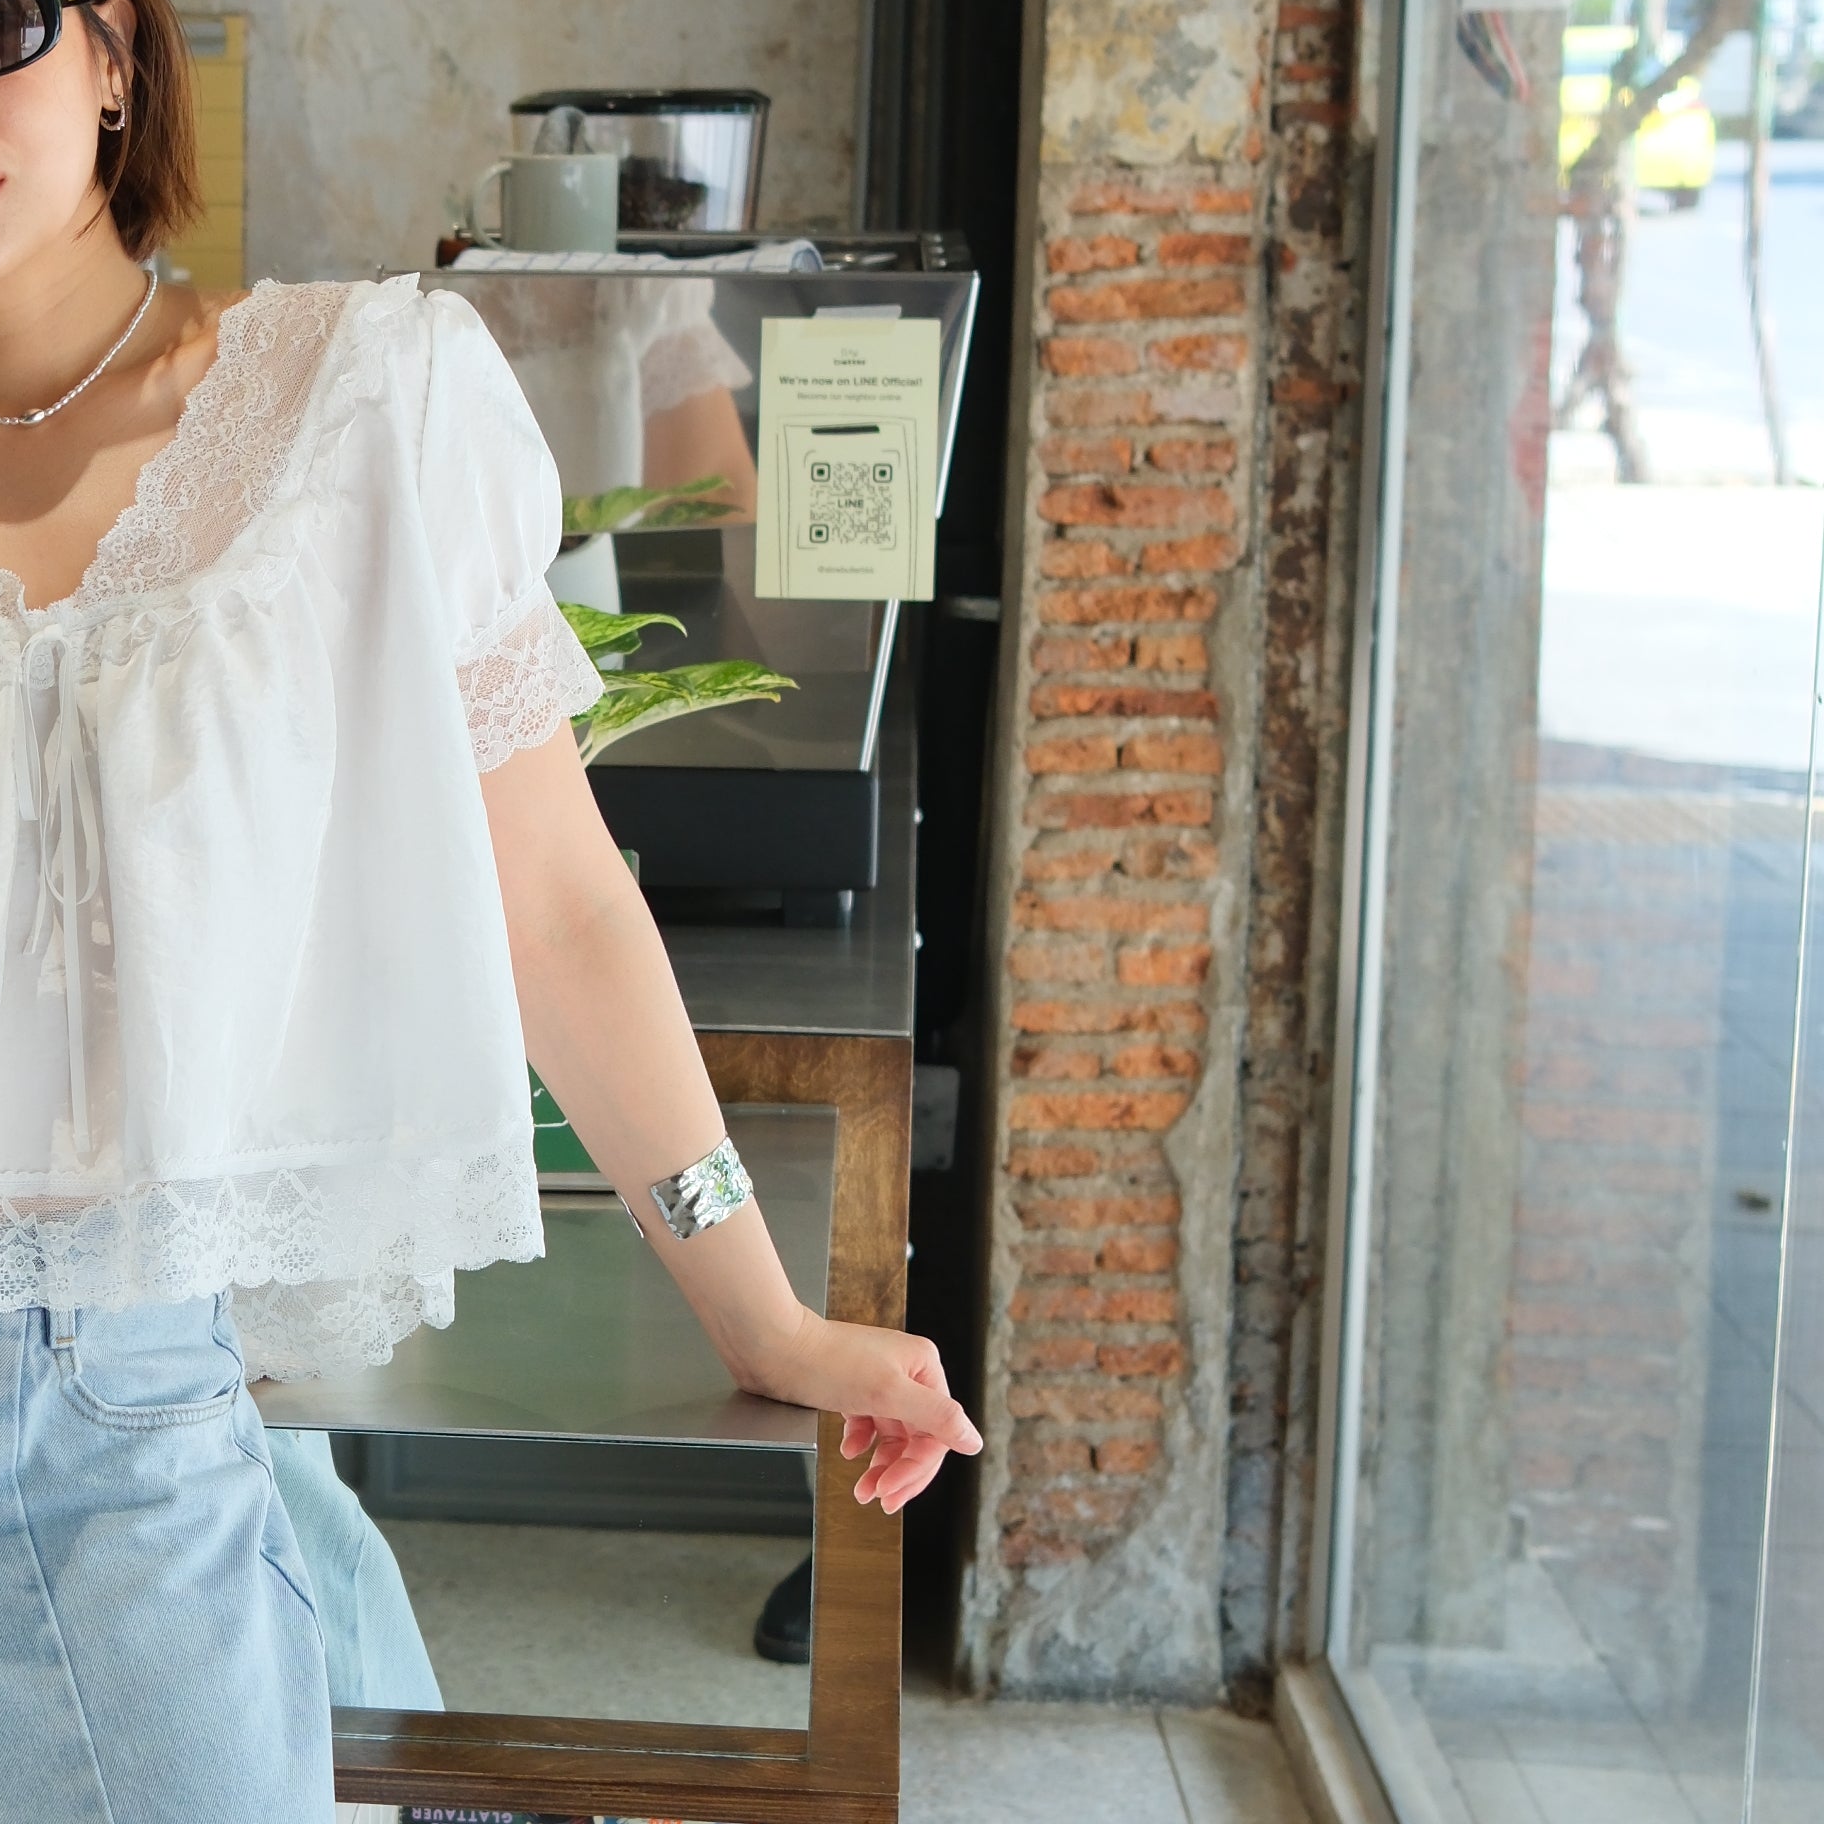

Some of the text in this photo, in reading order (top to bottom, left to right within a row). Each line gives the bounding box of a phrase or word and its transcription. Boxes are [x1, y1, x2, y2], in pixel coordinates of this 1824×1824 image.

[779, 376, 923, 387] We're now on LINE Official!
[837, 499, 864, 509] LINE
[411, 1807, 513, 1824] GLATTAUER
